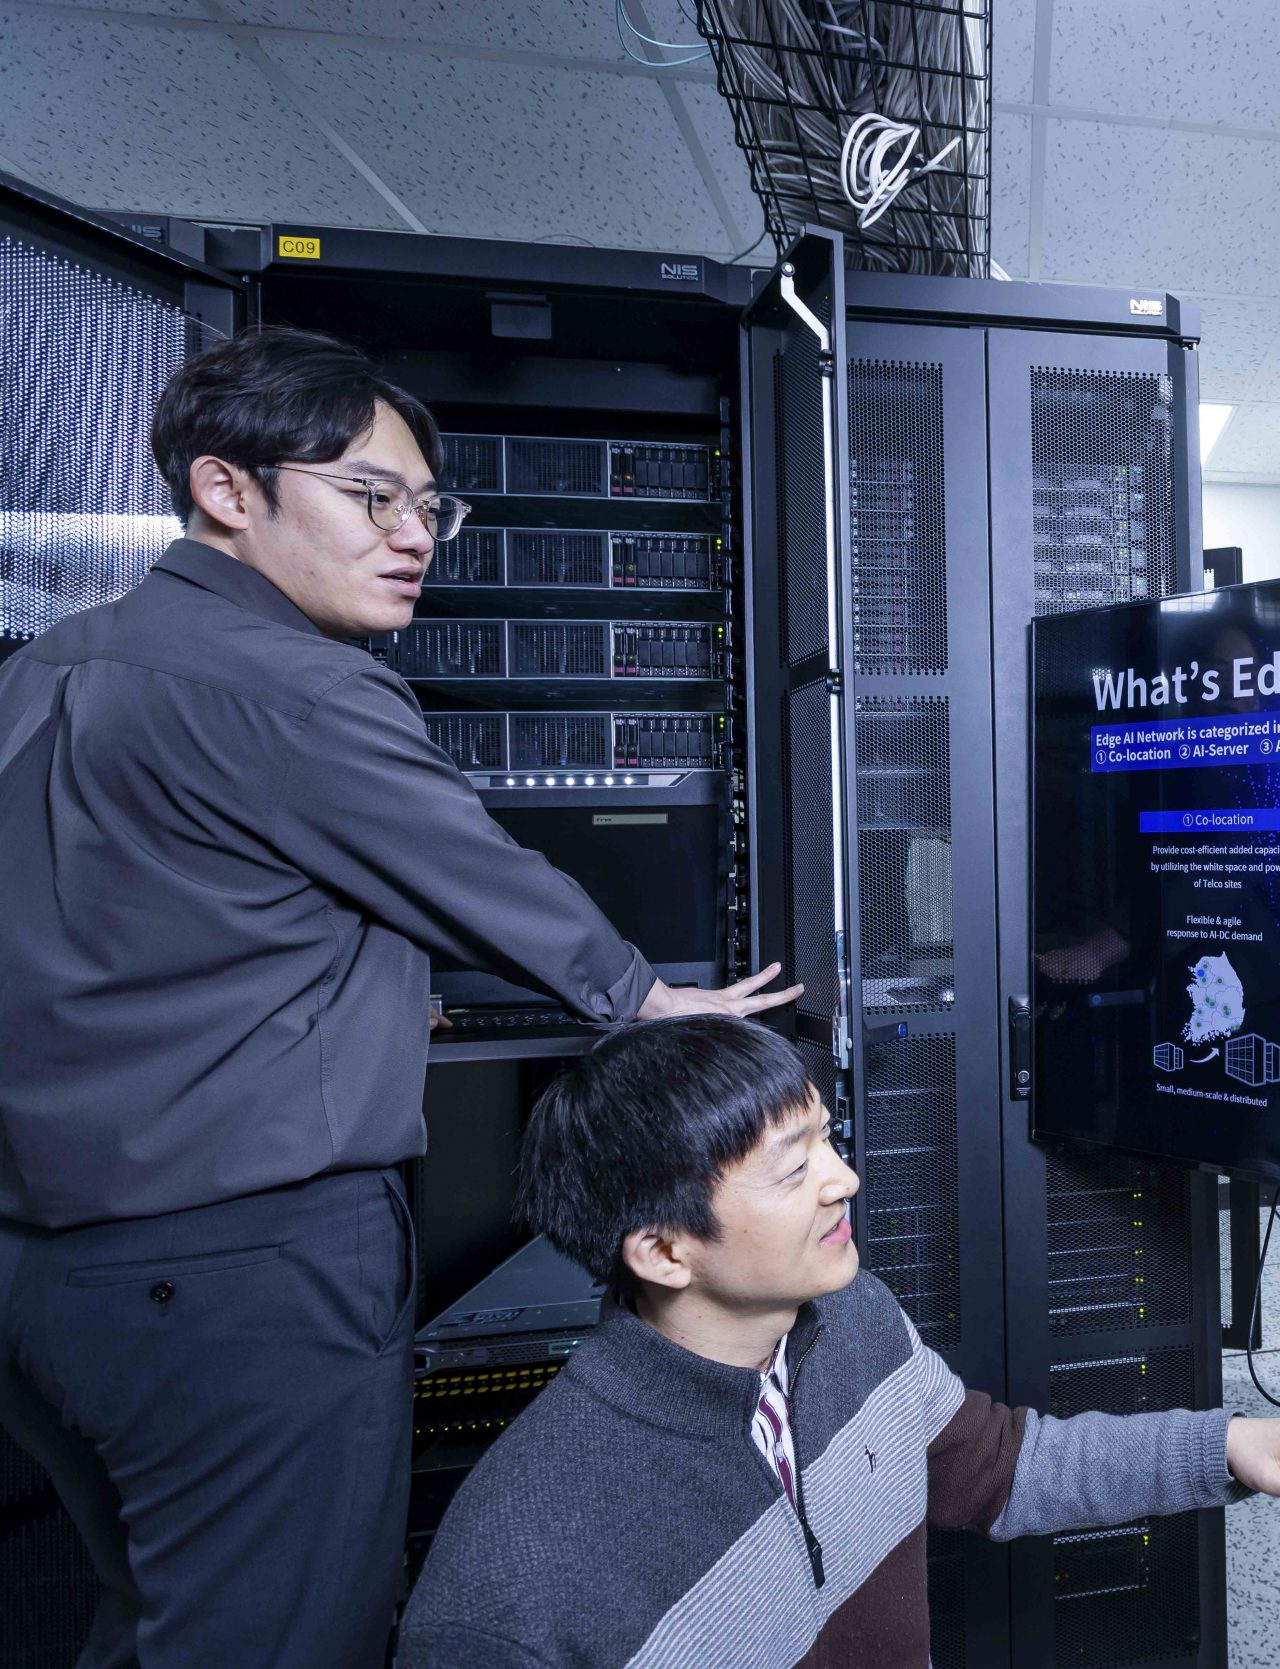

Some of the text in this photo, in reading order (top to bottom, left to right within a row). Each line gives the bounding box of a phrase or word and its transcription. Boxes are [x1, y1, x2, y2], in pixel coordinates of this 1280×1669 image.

[283, 240, 315, 254] C09
[661, 263, 698, 276] NIS
[1096, 733, 1121, 748] Edge
[1123, 732, 1134, 744] AI
[1137, 728, 1184, 743] Network
[1188, 726, 1196, 740] is
[1199, 722, 1269, 742] categorized
[1109, 748, 1171, 762] Co-location
[1193, 743, 1248, 757] AI-Server
[1195, 814, 1254, 825] Co-location
[1153, 846, 1179, 855] Provide
[1180, 846, 1227, 855] cost-efficient
[1229, 846, 1252, 855] added
[1151, 862, 1159, 872] by
[1161, 862, 1188, 872] utilizing
[1190, 863, 1202, 871] the
[1203, 863, 1223, 871] white
[1225, 865, 1247, 873] space
[1249, 863, 1263, 871] and
[1194, 879, 1242, 888] of Telco sites
[1186, 916, 1241, 927] Flexible & agile
[1167, 930, 1262, 941] response to AI-DC demand
[1156, 1084, 1175, 1094] Small,
[1177, 1088, 1222, 1100] medium-scale
[1230, 1094, 1267, 1107] distributed
